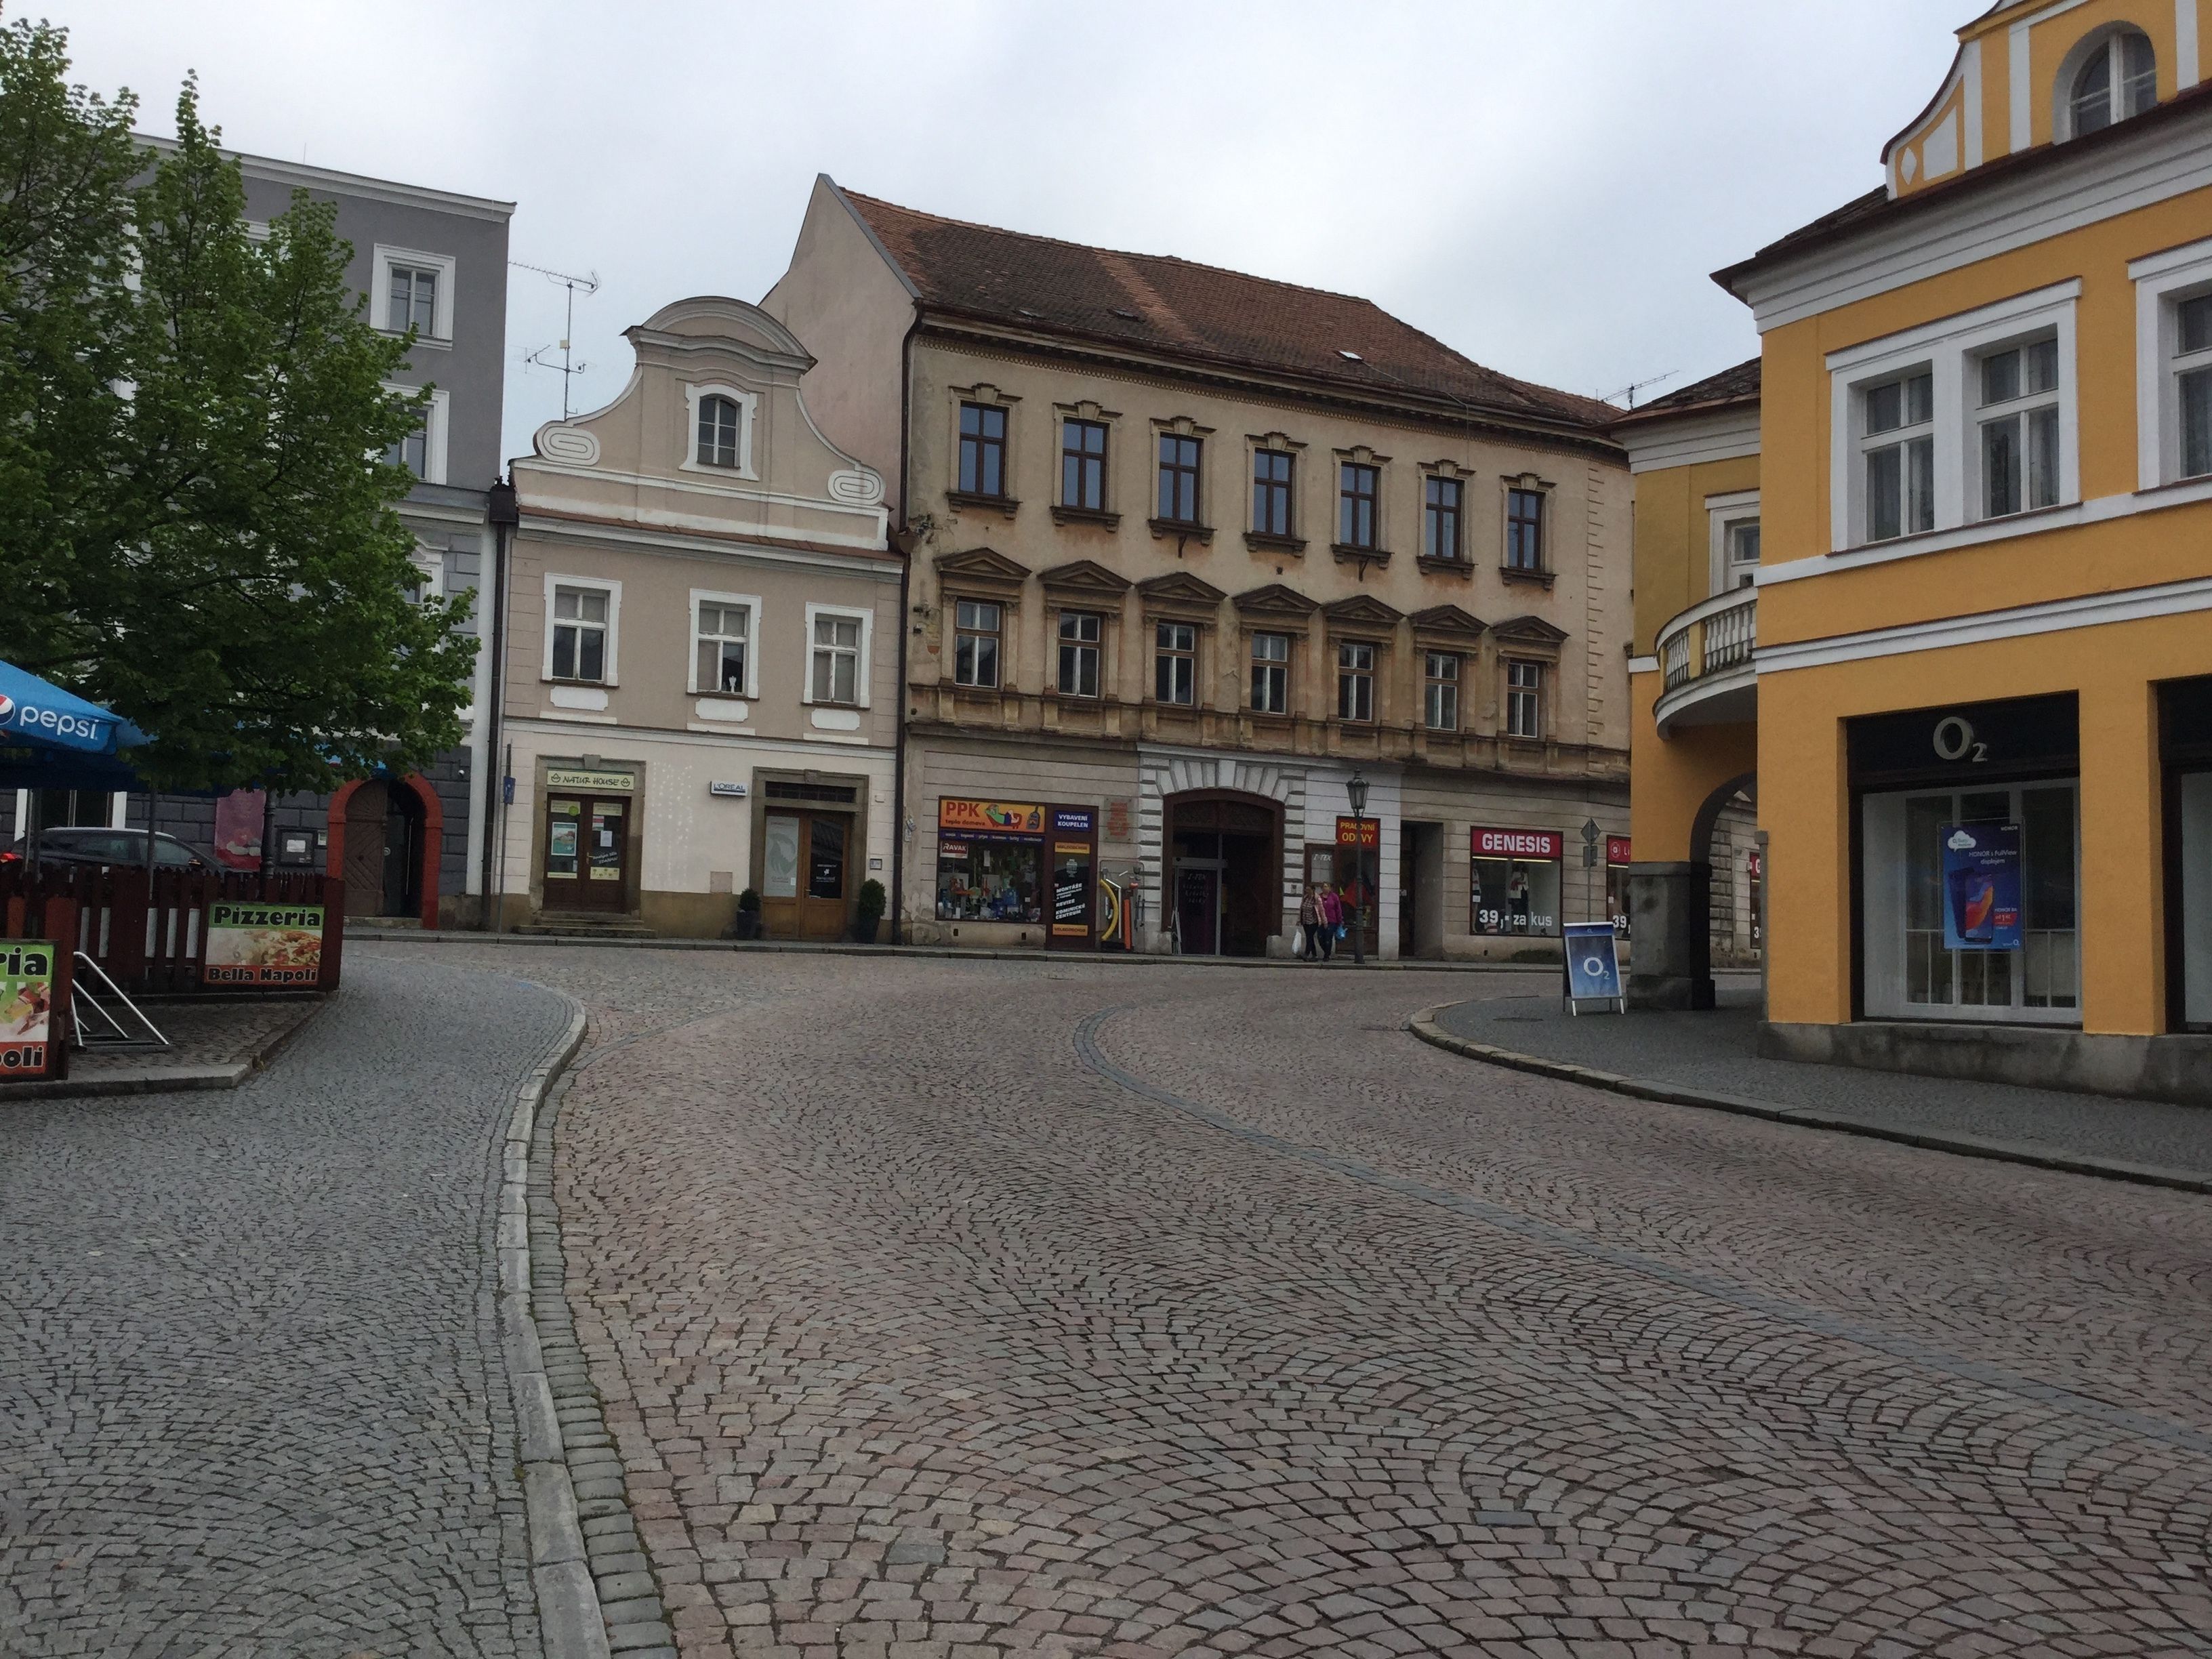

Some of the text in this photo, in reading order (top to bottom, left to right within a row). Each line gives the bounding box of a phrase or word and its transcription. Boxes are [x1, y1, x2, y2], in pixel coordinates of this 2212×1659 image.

[20, 705, 99, 739] pepsi
[562, 776, 619, 786] NATUR HOUSE
[946, 802, 980, 817] PPK
[1342, 832, 1373, 842] ODVY
[1482, 834, 1551, 853] GENESIS
[943, 842, 966, 851] RAVAK
[214, 906, 320, 926] Pizzeria
[1056, 909, 1082, 920] CENTRUM
[1513, 914, 1526, 926] za
[1531, 912, 1552, 926] kus
[208, 968, 318, 983] Bella Napoli
